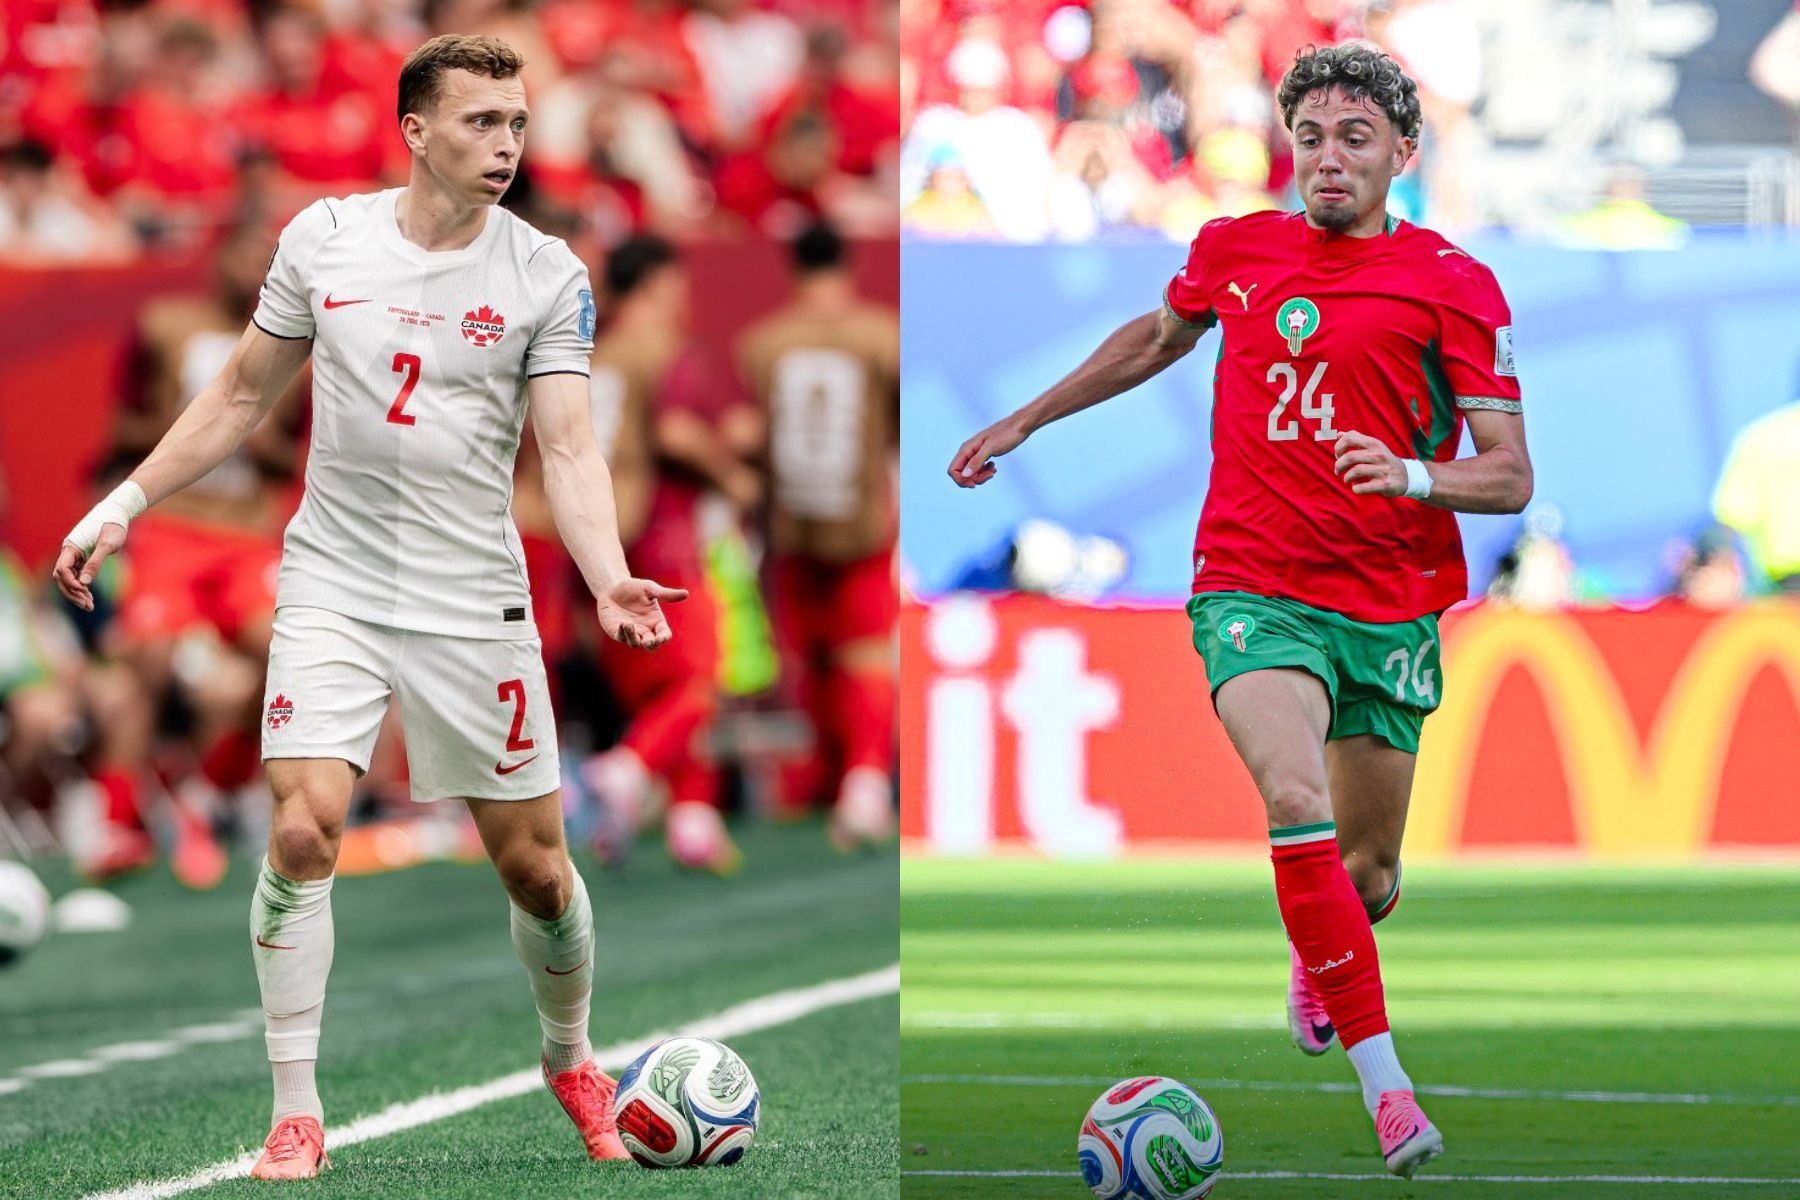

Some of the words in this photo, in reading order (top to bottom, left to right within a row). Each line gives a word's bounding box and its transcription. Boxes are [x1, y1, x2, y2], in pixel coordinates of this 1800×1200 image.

[461, 320, 504, 333] CANADA
[386, 352, 421, 426] 2
[1266, 361, 1338, 441] 24
[497, 678, 535, 753] 2
[925, 597, 1125, 864] it
